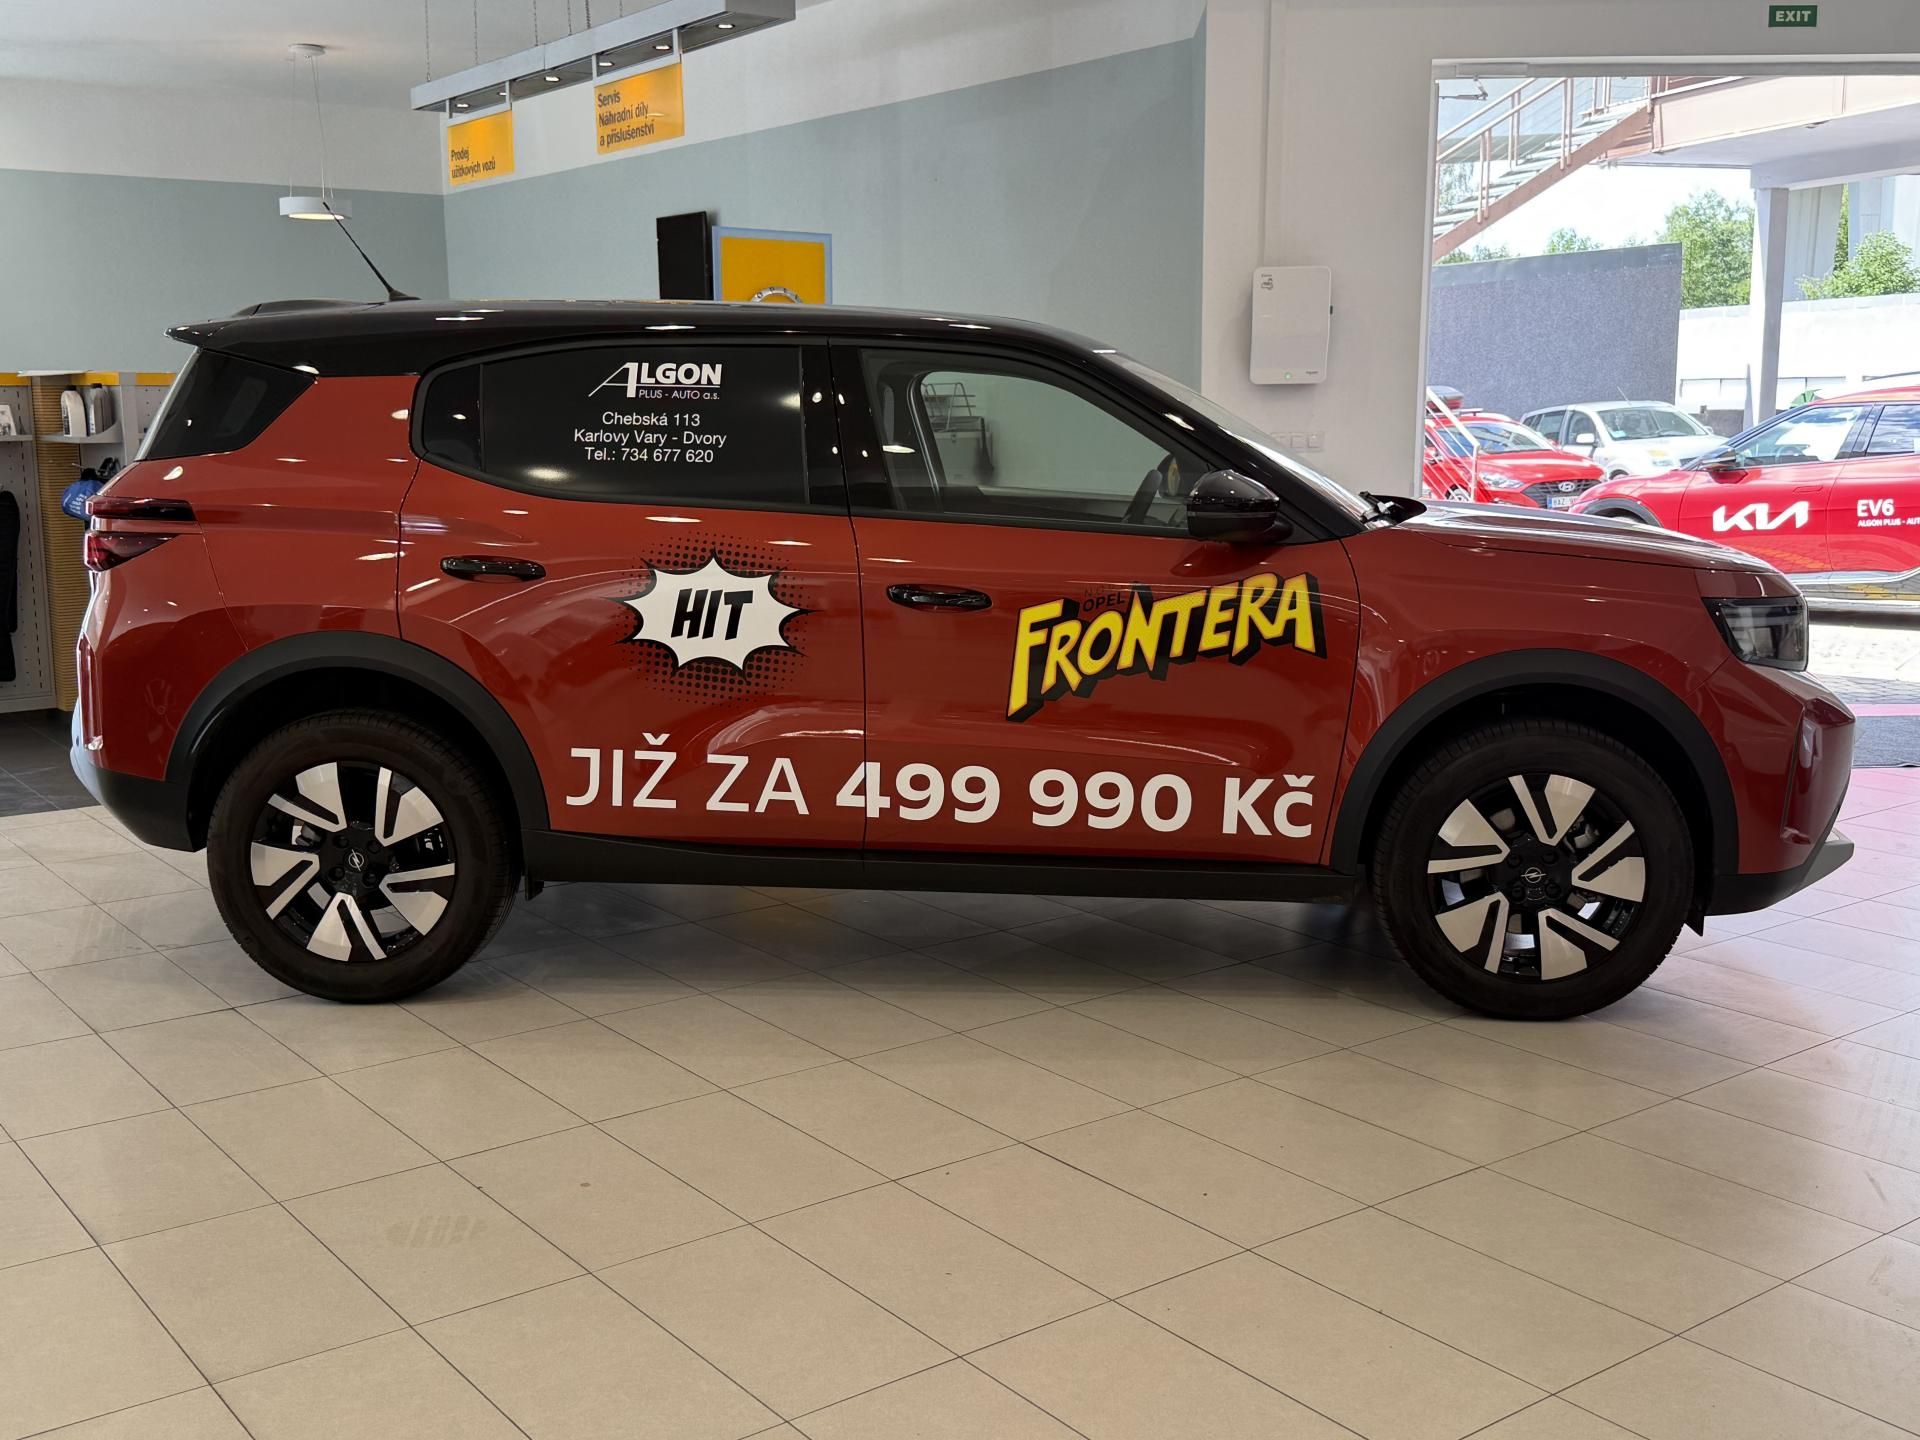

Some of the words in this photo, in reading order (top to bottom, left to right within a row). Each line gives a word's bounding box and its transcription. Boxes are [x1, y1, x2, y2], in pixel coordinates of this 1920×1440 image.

[1775, 10, 1812, 22] EXIT
[598, 89, 621, 108] Servis
[598, 104, 634, 128] Náhradní
[635, 102, 649, 120] díly
[600, 135, 605, 146] a
[451, 147, 470, 162] Prodej
[588, 362, 723, 398] ALGON
[638, 389, 663, 399] PLUS
[671, 390, 700, 400] AUTO
[702, 391, 720, 400] a.s.
[602, 411, 669, 426] Chebská
[673, 413, 701, 427] 113
[574, 428, 630, 446] Karlovy
[634, 430, 668, 447] Vary
[683, 431, 727, 448] Dvory
[584, 446, 616, 461] Tel.:
[621, 448, 648, 462] 734
[653, 449, 681, 462] 677
[685, 450, 714, 463] 620
[1712, 501, 1809, 532] KIA
[1857, 498, 1895, 517] EV6
[1857, 519, 1883, 527] ALGON
[1083, 591, 1126, 612] OPEL
[671, 588, 753, 640] HIT
[1006, 572, 1322, 720] FRONTERA
[565, 732, 677, 809] JIŽ
[705, 753, 810, 815] ZA
[835, 761, 1000, 823] 499
[1029, 768, 1192, 832] 990
[1222, 774, 1315, 838] Kč
